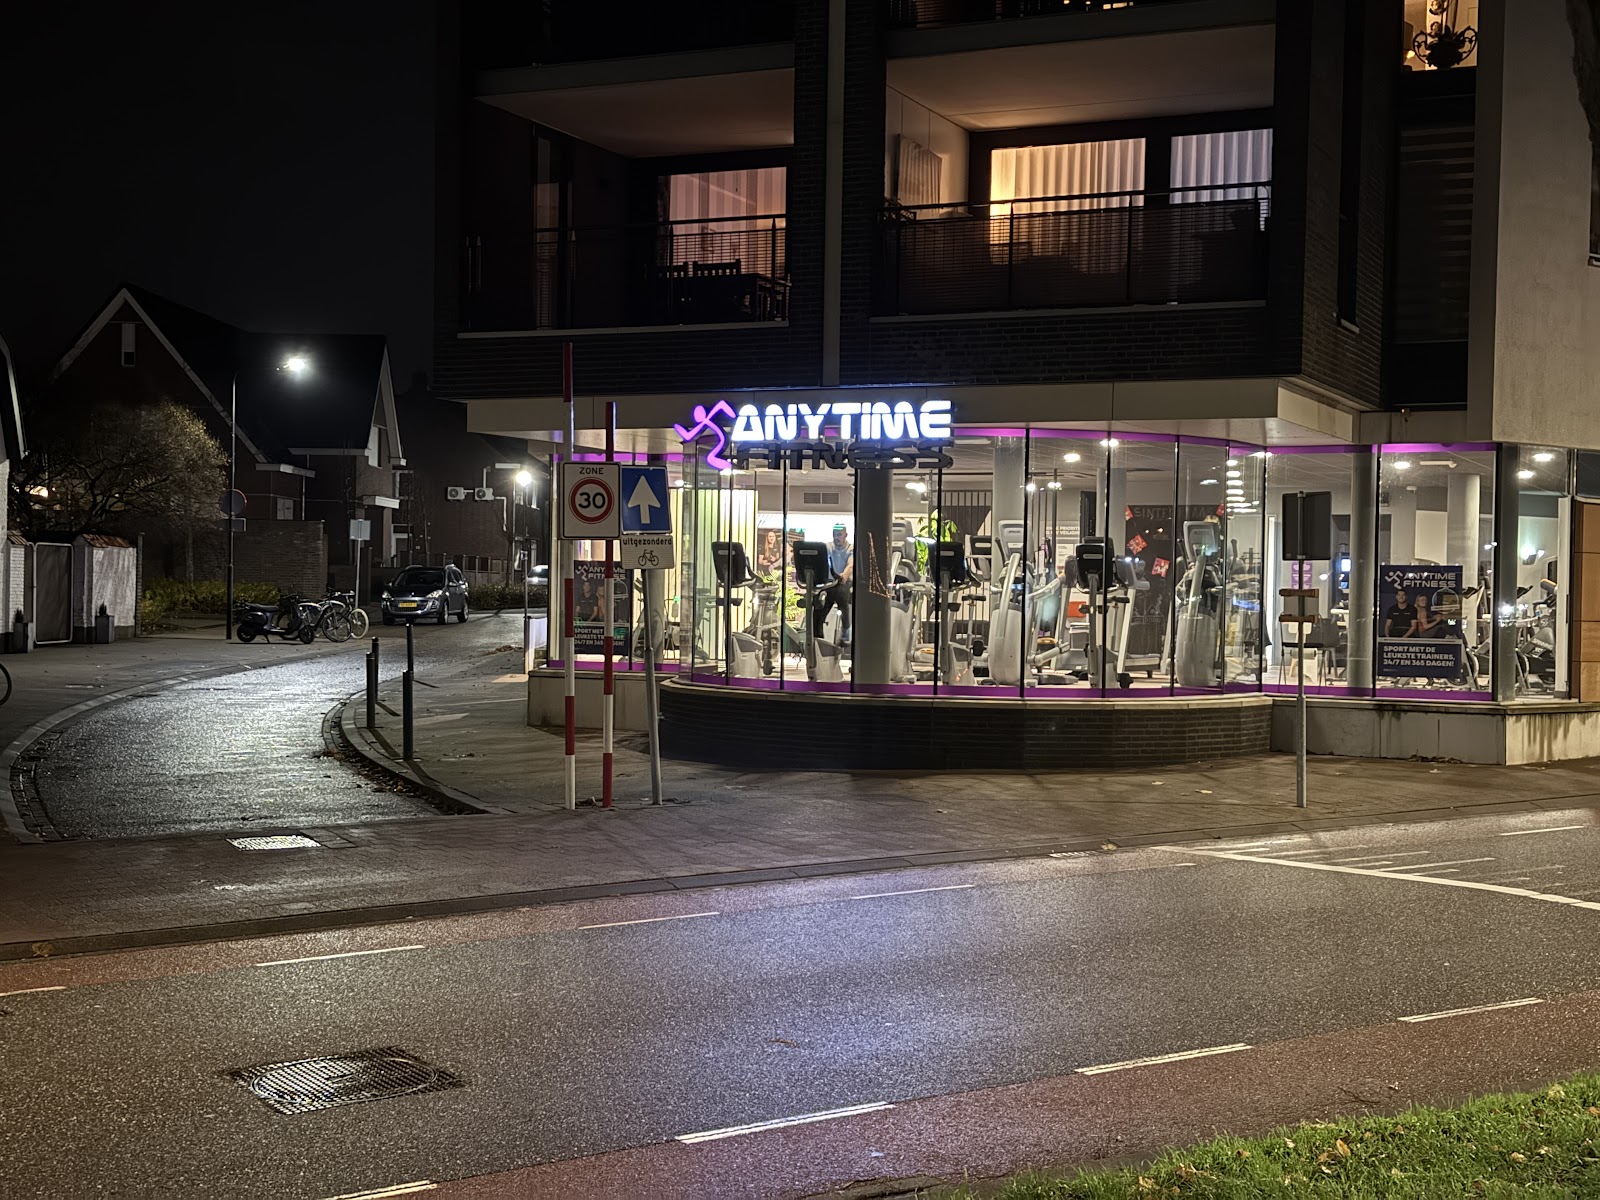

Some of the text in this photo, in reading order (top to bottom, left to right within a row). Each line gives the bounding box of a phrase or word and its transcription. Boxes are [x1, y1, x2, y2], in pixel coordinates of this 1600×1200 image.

[731, 400, 952, 441] ANYTIME
[735, 440, 953, 470] FITNESS
[579, 466, 604, 475] ZONE
[578, 492, 606, 509] 30
[622, 537, 672, 547] uitgezonderd
[1403, 572, 1456, 580] ANYTIME
[1403, 580, 1456, 588] FITNESS
